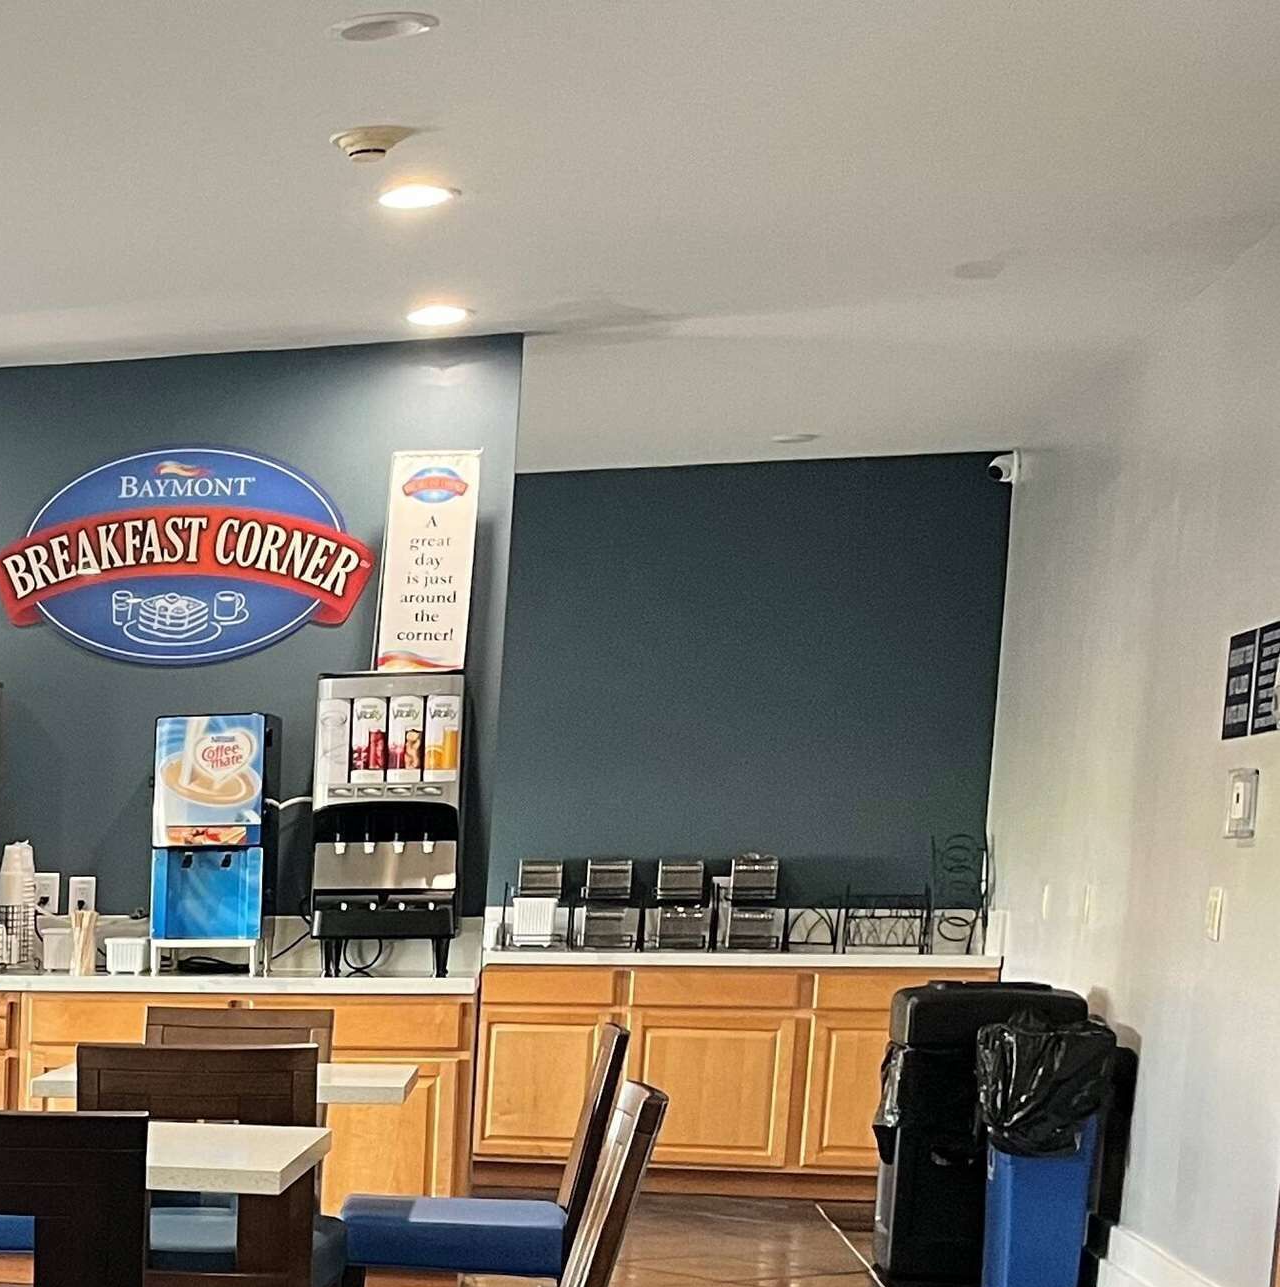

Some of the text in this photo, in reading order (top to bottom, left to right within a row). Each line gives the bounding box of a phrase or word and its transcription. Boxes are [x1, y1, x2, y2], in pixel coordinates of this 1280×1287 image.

[118, 475, 253, 498] BAYMONT
[425, 515, 438, 528] A
[409, 536, 452, 551] great
[2, 517, 360, 600] BREAKFAST CORNER
[414, 553, 443, 570] day
[406, 571, 454, 588] is just
[400, 591, 458, 604] around
[414, 609, 440, 623] the
[396, 627, 454, 642] corner!
[202, 744, 240, 762] Coffee
